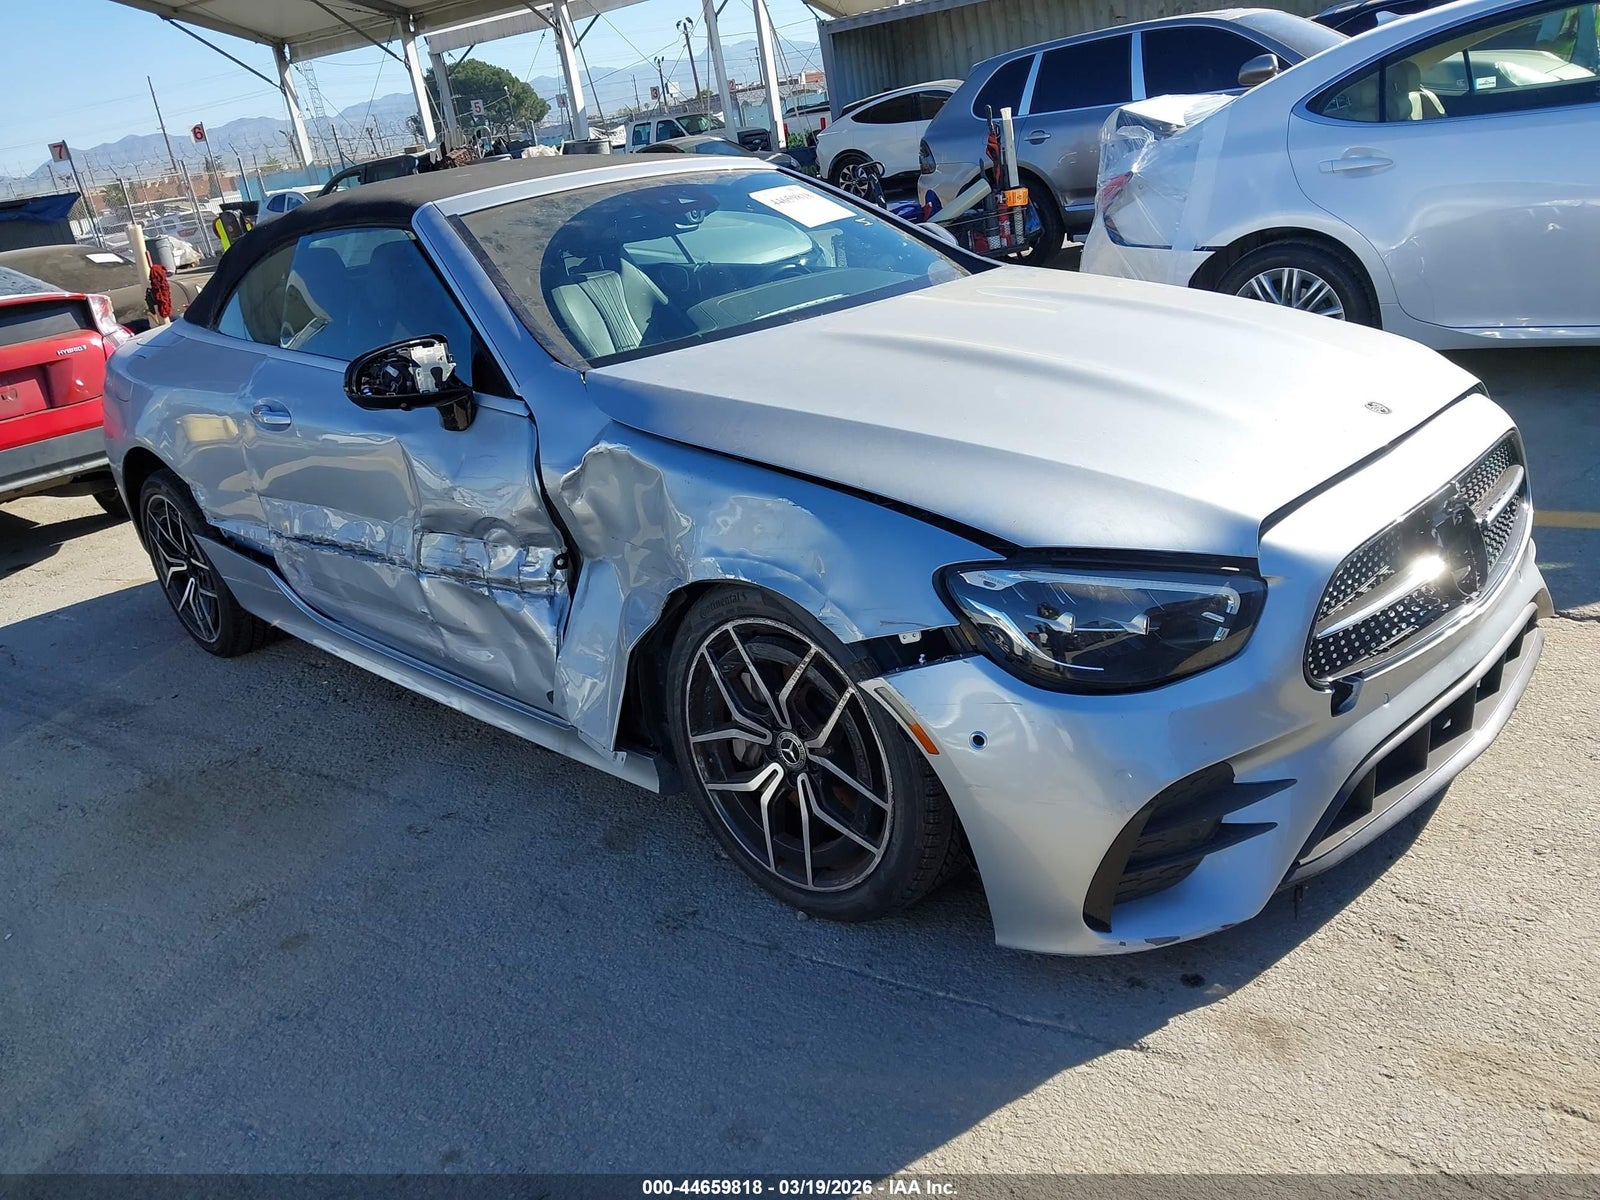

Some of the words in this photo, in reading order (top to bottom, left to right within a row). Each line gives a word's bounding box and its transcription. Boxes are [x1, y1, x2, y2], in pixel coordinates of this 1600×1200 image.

[473, 101, 481, 114] 5
[193, 126, 203, 140] 6
[52, 144, 63, 159] 7
